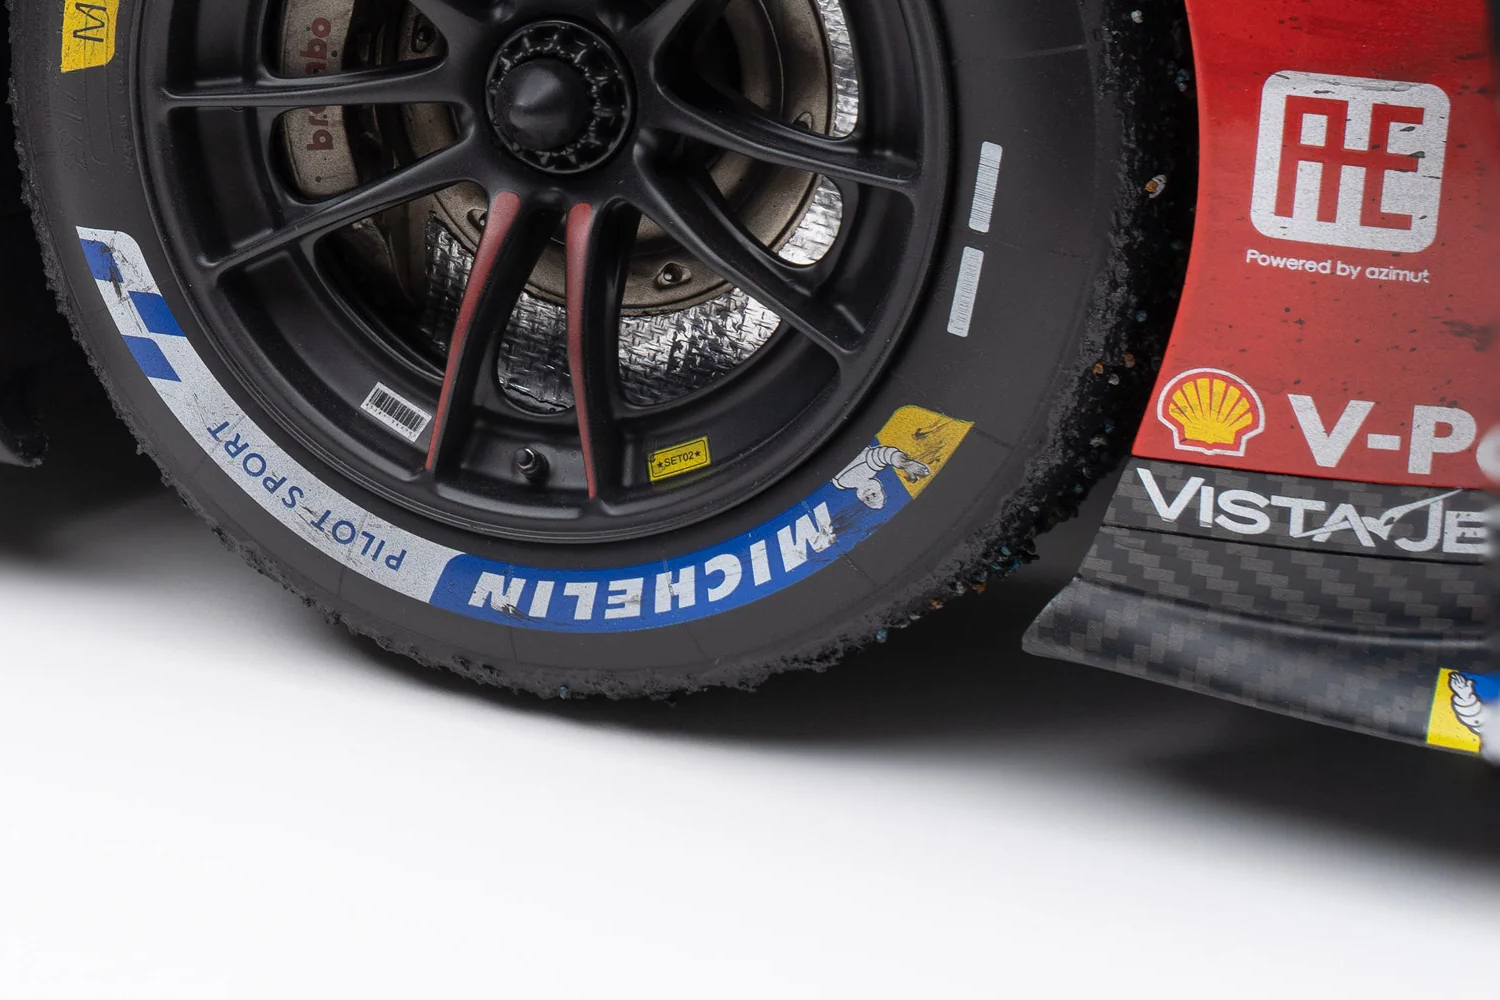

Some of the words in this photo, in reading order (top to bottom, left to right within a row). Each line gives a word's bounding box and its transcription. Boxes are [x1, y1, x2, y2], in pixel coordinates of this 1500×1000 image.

[1246, 248, 1332, 274] Powered
[1336, 260, 1361, 280] by
[1365, 264, 1431, 284] azimut
[206, 421, 305, 509] SPORT
[309, 509, 407, 571] PILOT
[467, 501, 838, 621] MICHELIN
